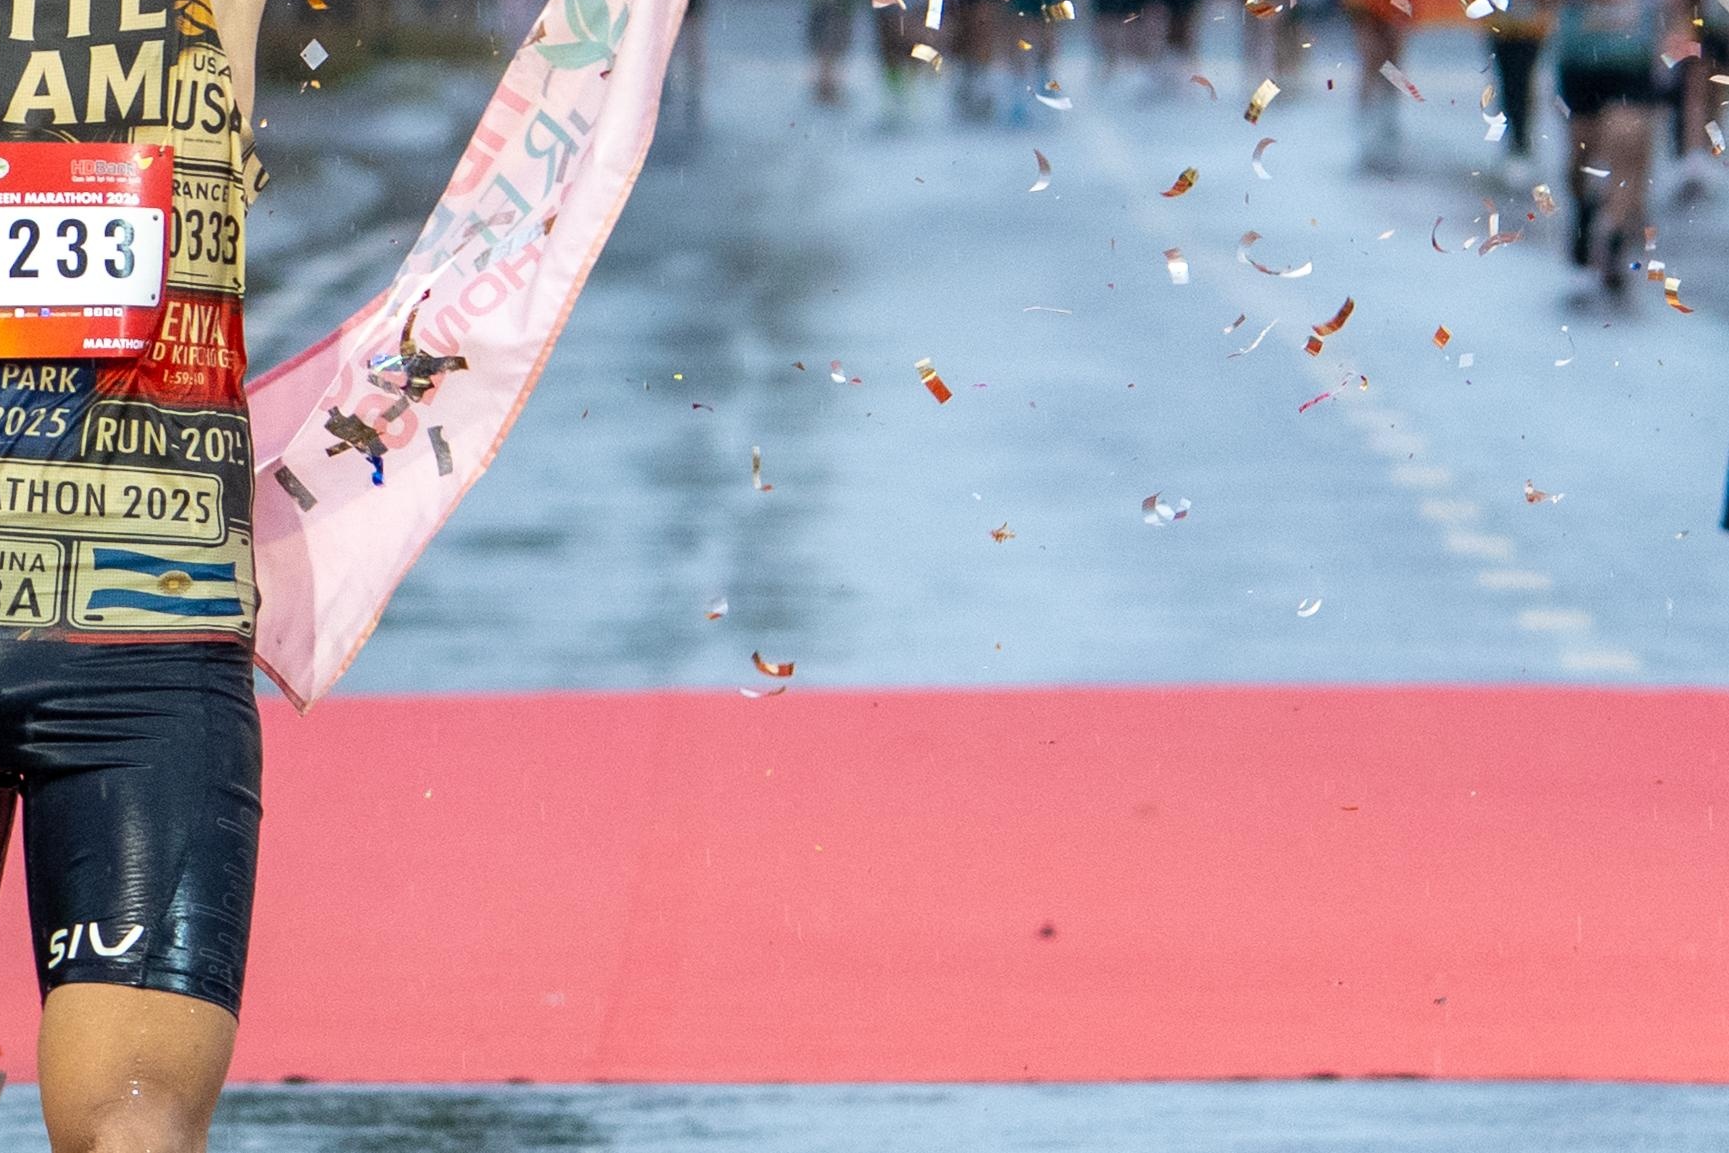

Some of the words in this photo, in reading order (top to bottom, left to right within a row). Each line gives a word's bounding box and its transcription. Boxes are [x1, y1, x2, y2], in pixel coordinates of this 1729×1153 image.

[192, 53, 232, 84] USA
[24, 192, 103, 205] MARATHON
[106, 192, 141, 206] 2026
[171, 178, 230, 203] RANCE
[160, 300, 226, 348] ENYA
[0, 363, 81, 394] PARK
[123, 485, 212, 525] 2025
